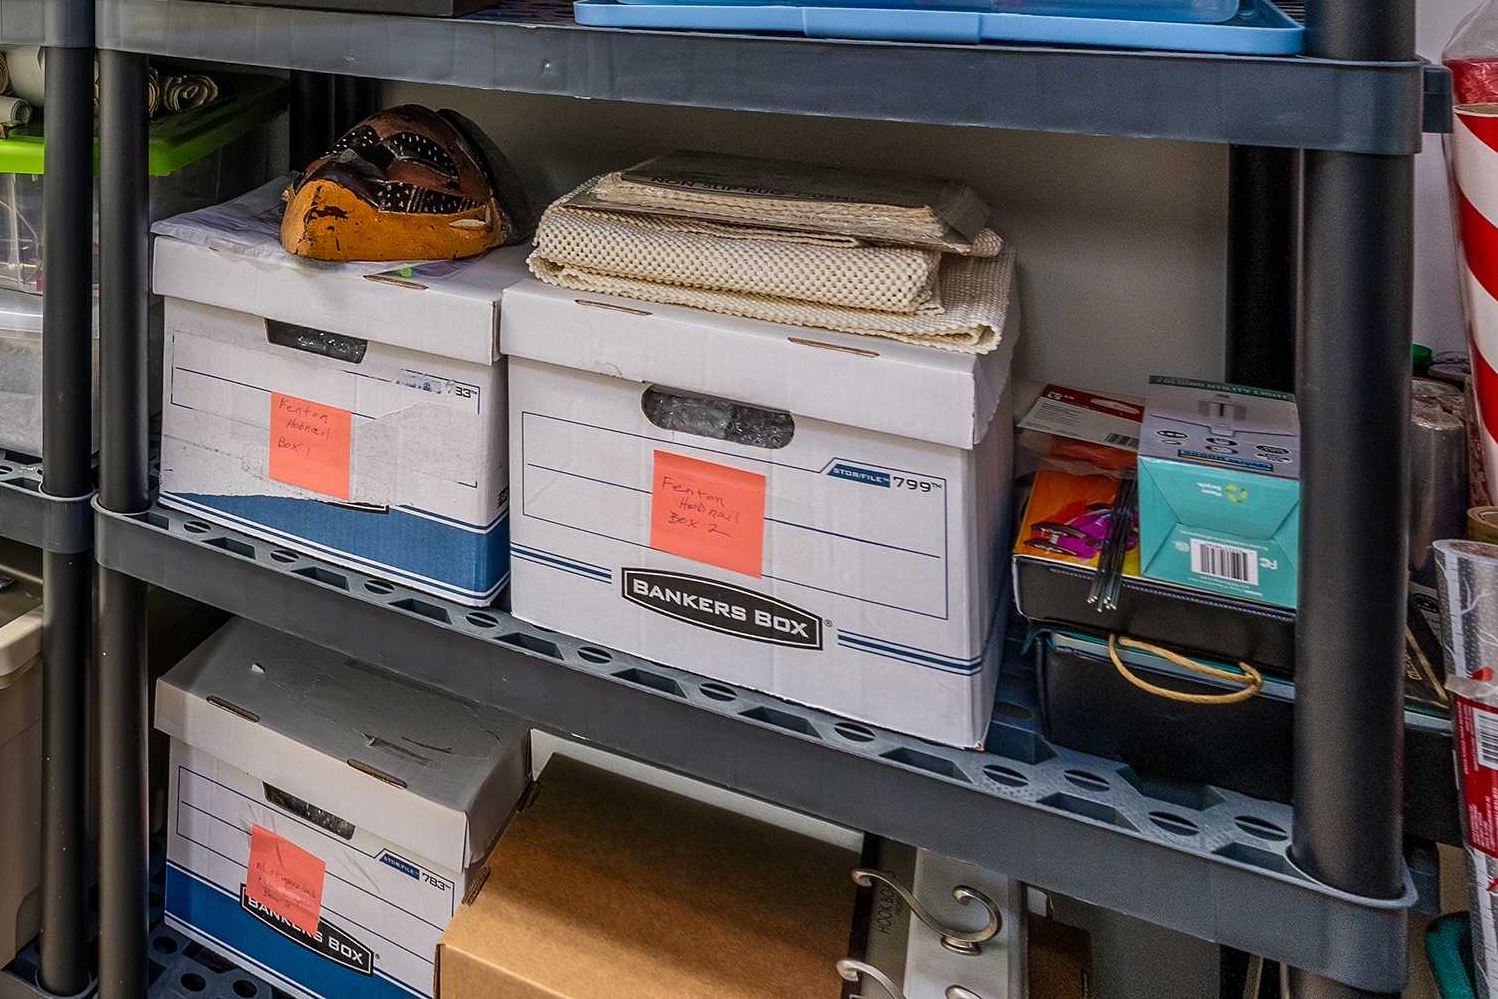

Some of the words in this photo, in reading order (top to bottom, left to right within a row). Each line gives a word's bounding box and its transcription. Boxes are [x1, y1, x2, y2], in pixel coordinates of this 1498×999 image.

[1208, 384, 1252, 394] UTILITY
[1253, 389, 1289, 400] LIGHT
[279, 397, 328, 424] Fenton
[286, 418, 331, 440] Hobnail
[278, 436, 303, 452] Box
[662, 476, 725, 508] Fenton
[668, 510, 698, 528] Box
[1259, 557, 1278, 570] FC
[633, 578, 747, 622] BANKERS
[754, 609, 810, 639] BOX
[876, 904, 893, 934] HOOK
[328, 936, 364, 966] BOX
